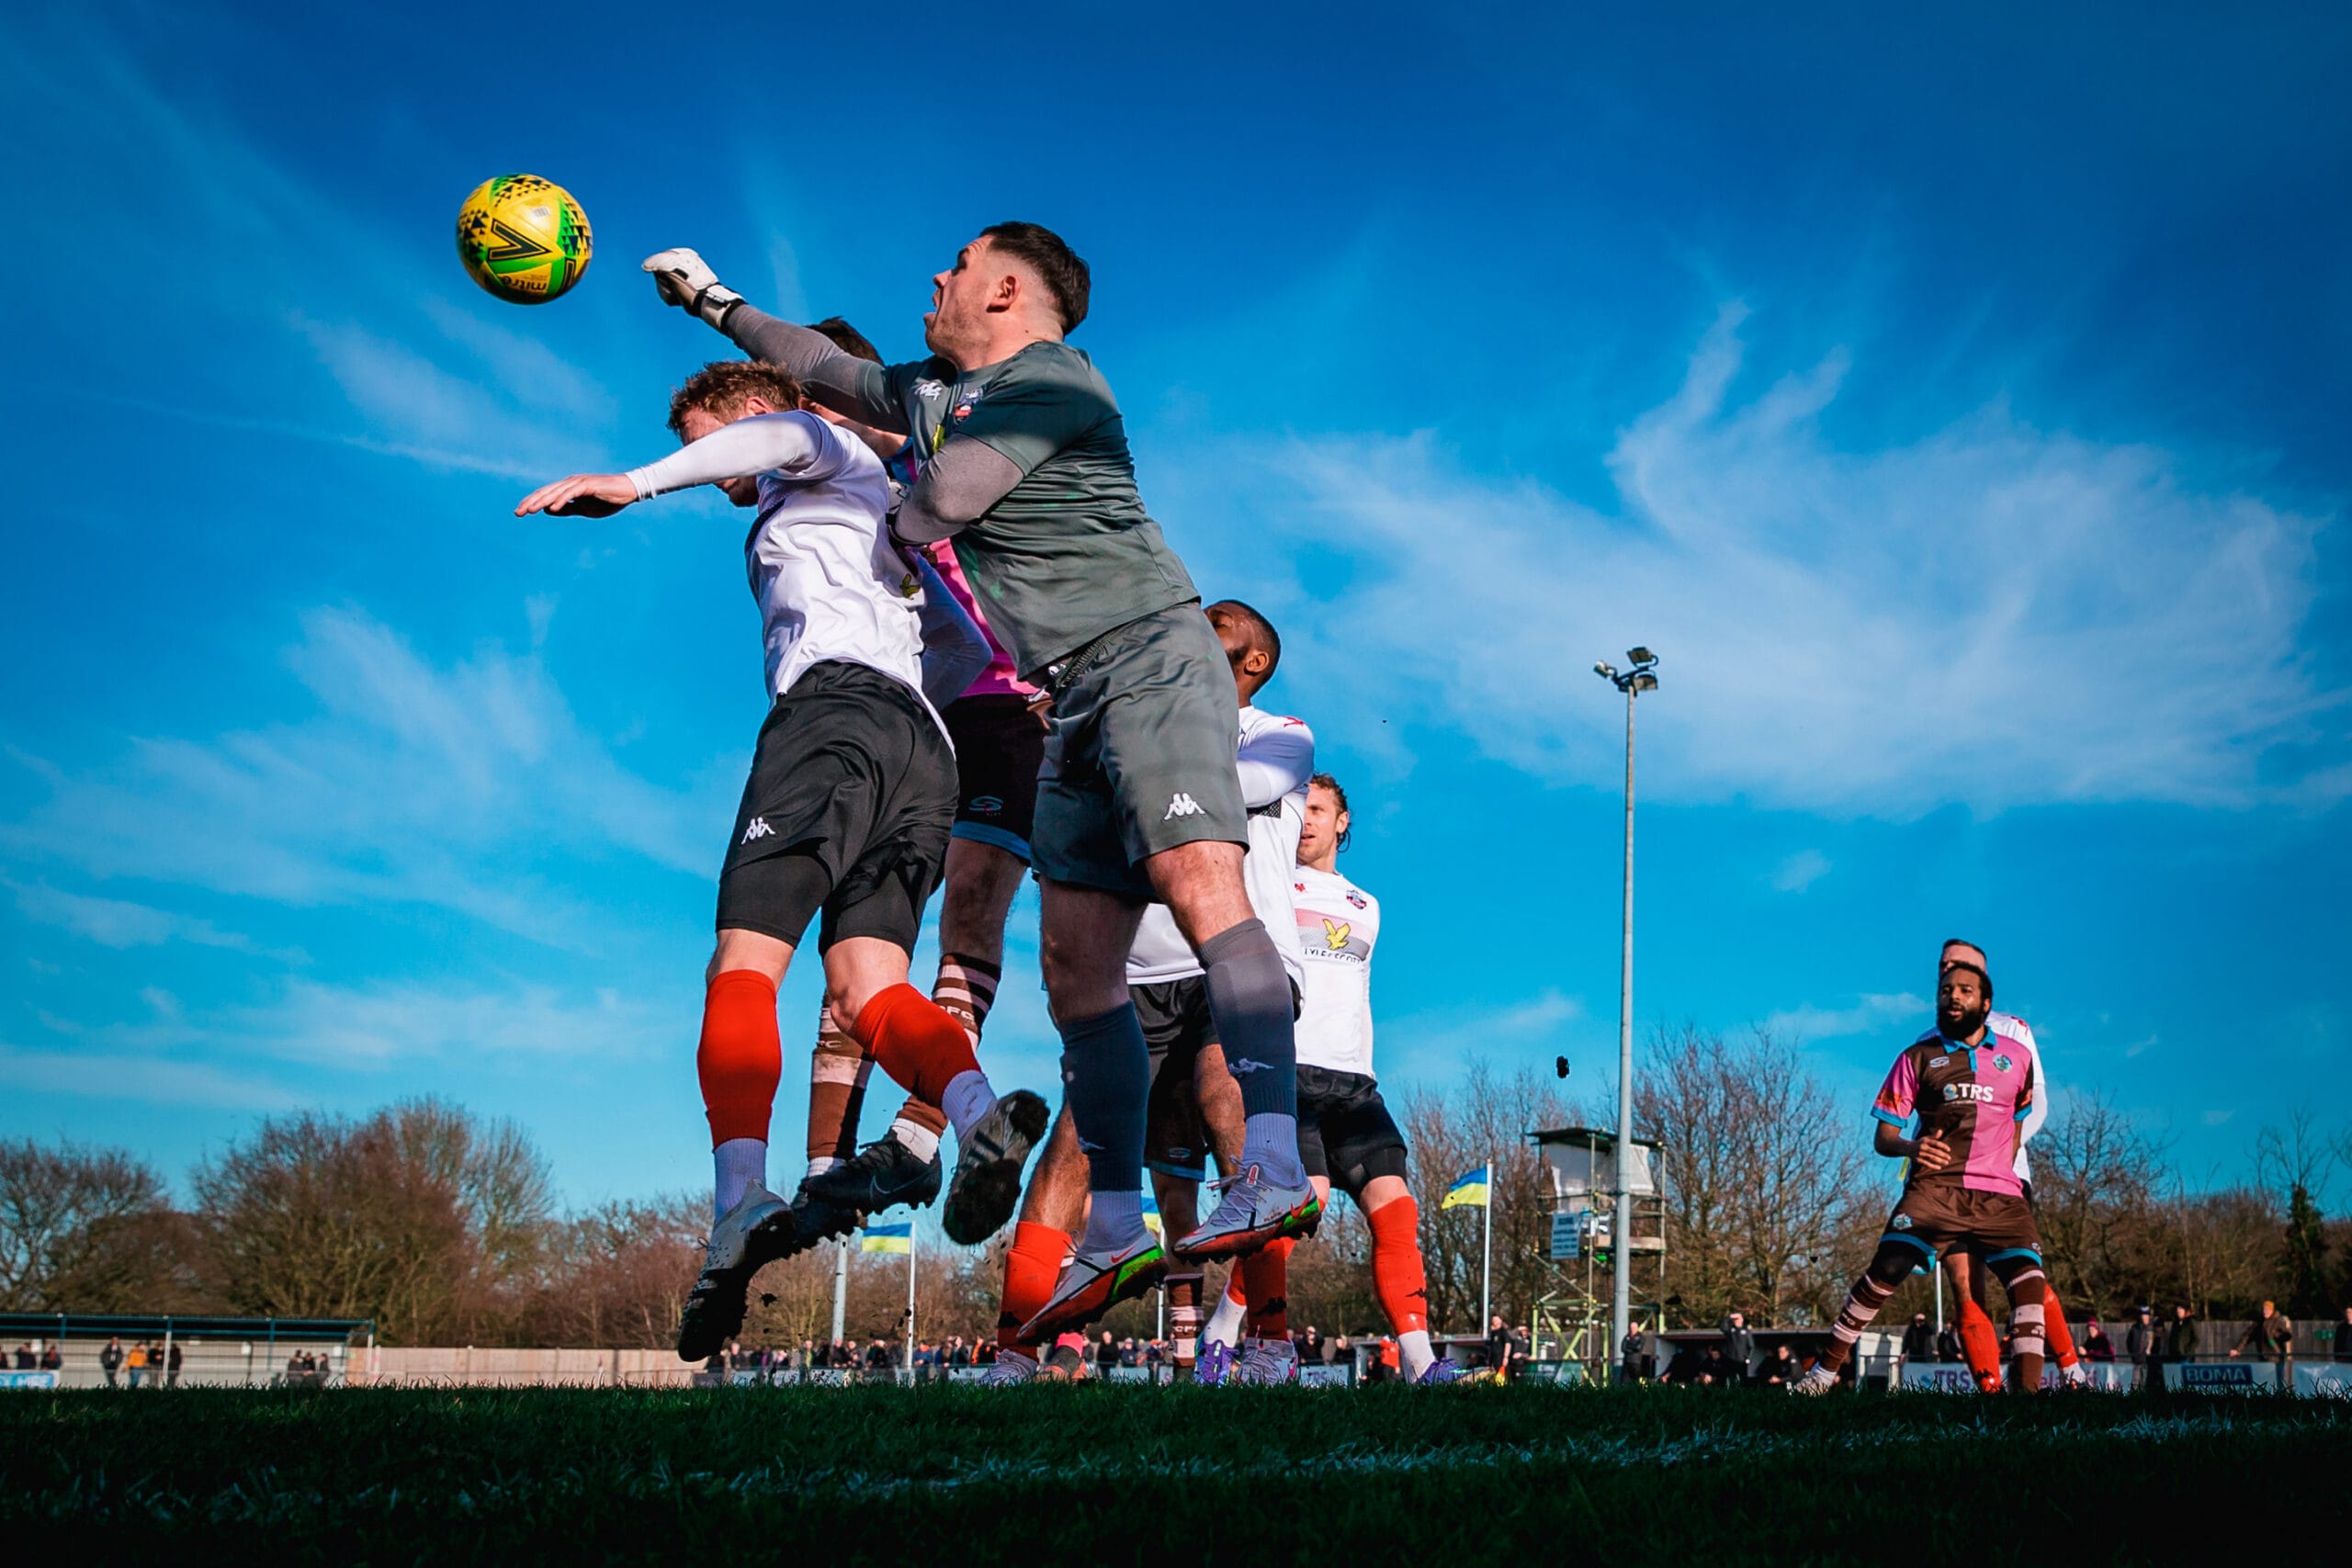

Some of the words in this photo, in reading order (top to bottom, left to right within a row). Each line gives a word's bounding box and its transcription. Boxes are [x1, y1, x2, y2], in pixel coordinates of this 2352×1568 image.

[502, 276, 547, 290] mitre
[1958, 1083, 1994, 1102] TRS
[1934, 1369, 1971, 1388] TRS
[2186, 1367, 2246, 1382] BOMA
